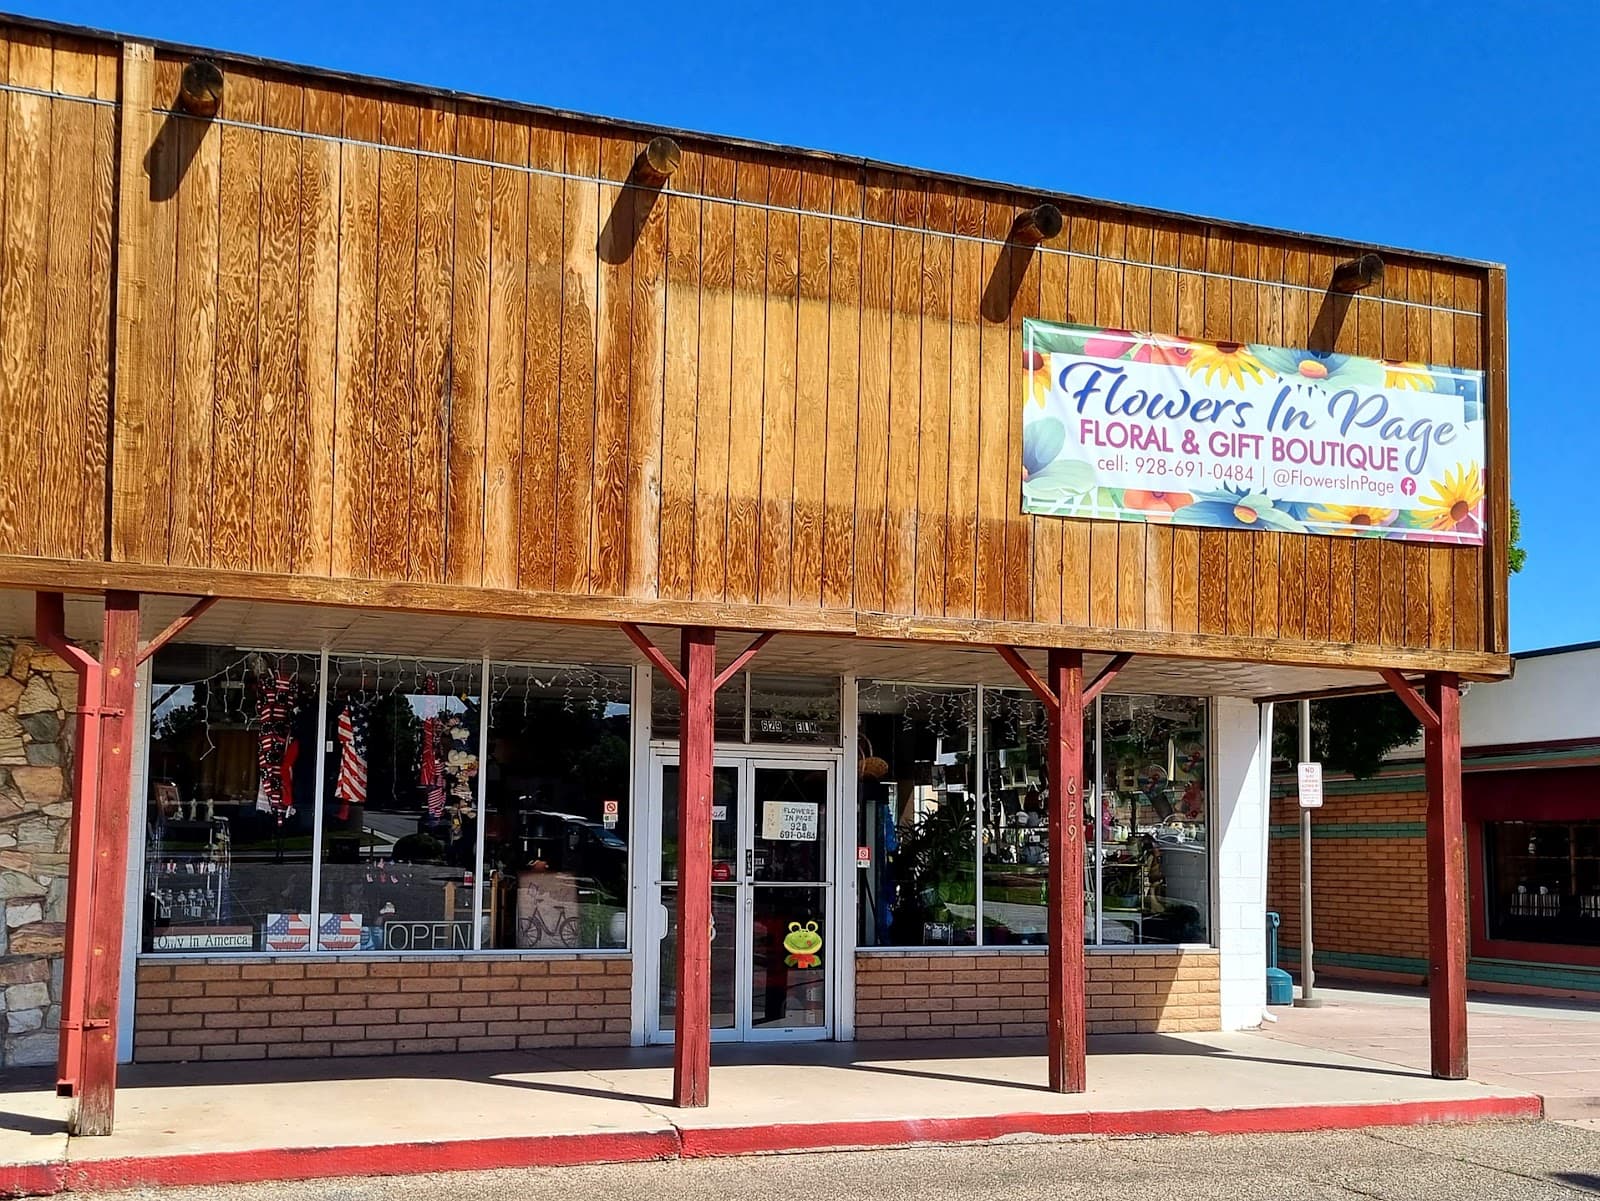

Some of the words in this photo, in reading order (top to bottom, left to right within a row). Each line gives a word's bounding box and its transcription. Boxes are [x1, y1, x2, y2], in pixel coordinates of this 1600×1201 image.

[1058, 361, 1254, 429] Flowers
[1266, 384, 1317, 433] In
[1327, 388, 1457, 475] Page
[1080, 418, 1174, 453] FLORAL
[1181, 429, 1200, 455] &
[1208, 430, 1264, 460] GIFT
[1272, 436, 1399, 472] BOUTIQUE
[1097, 454, 1129, 473] cell:
[1135, 456, 1254, 482] 928-691-0484
[1273, 468, 1395, 497] @FlowersInPage
[761, 720, 783, 733] 629
[1066, 776, 1077, 842] 629
[790, 822, 807, 832] 928
[190, 936, 199, 947] In
[205, 935, 248, 946] America
[388, 924, 471, 950] OPEN
